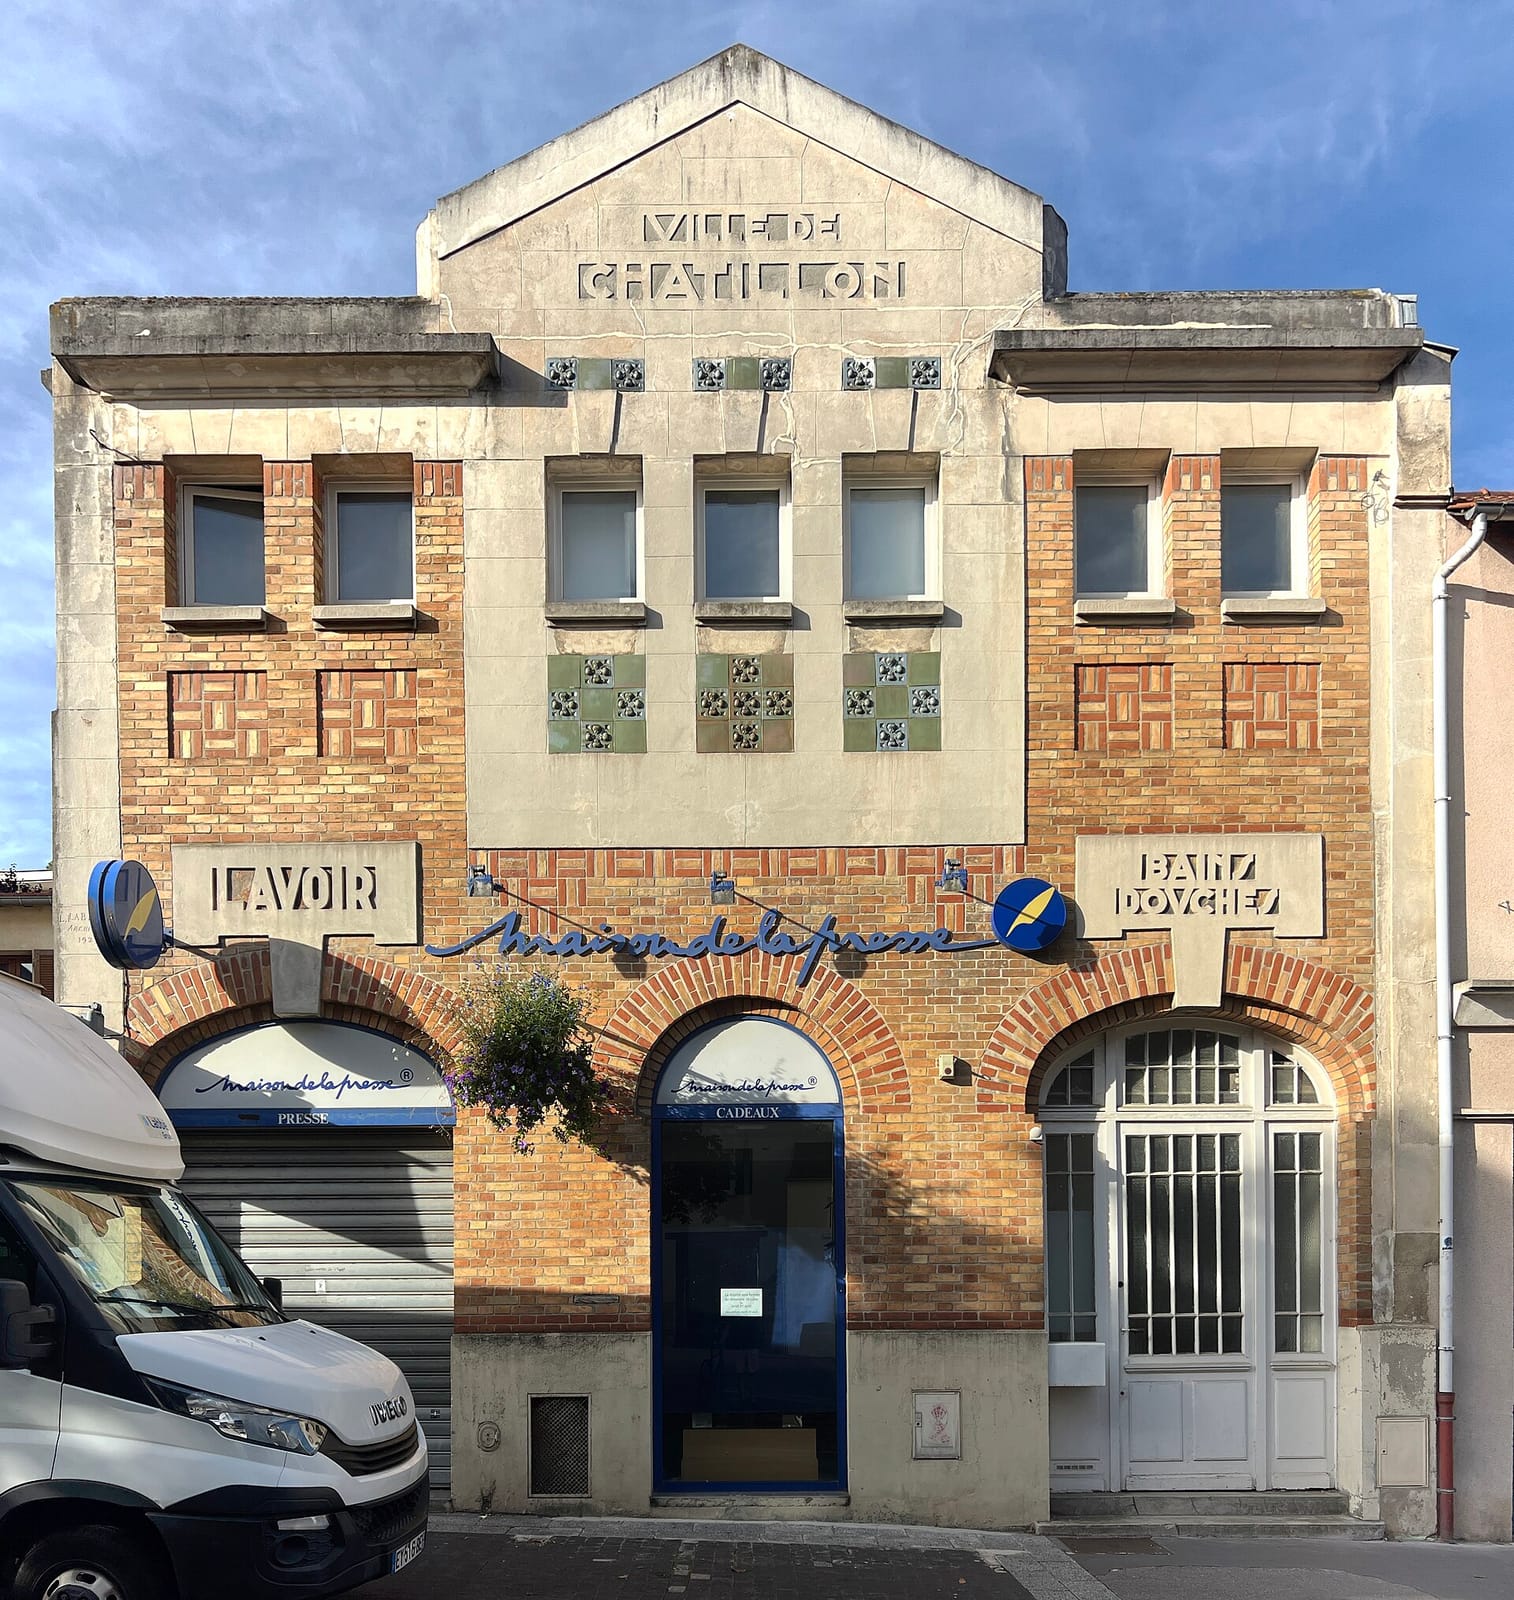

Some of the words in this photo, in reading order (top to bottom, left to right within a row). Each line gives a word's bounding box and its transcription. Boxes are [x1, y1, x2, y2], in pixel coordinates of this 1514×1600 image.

[643, 213, 768, 242] VILLE
[788, 213, 841, 241] DE
[578, 263, 906, 299] CHATILLON
[212, 866, 377, 911] LAVOIR
[278, 1113, 329, 1125] PRESSE
[716, 1107, 779, 1119] CADEAUX
[369, 1396, 407, 1426] IVECO
